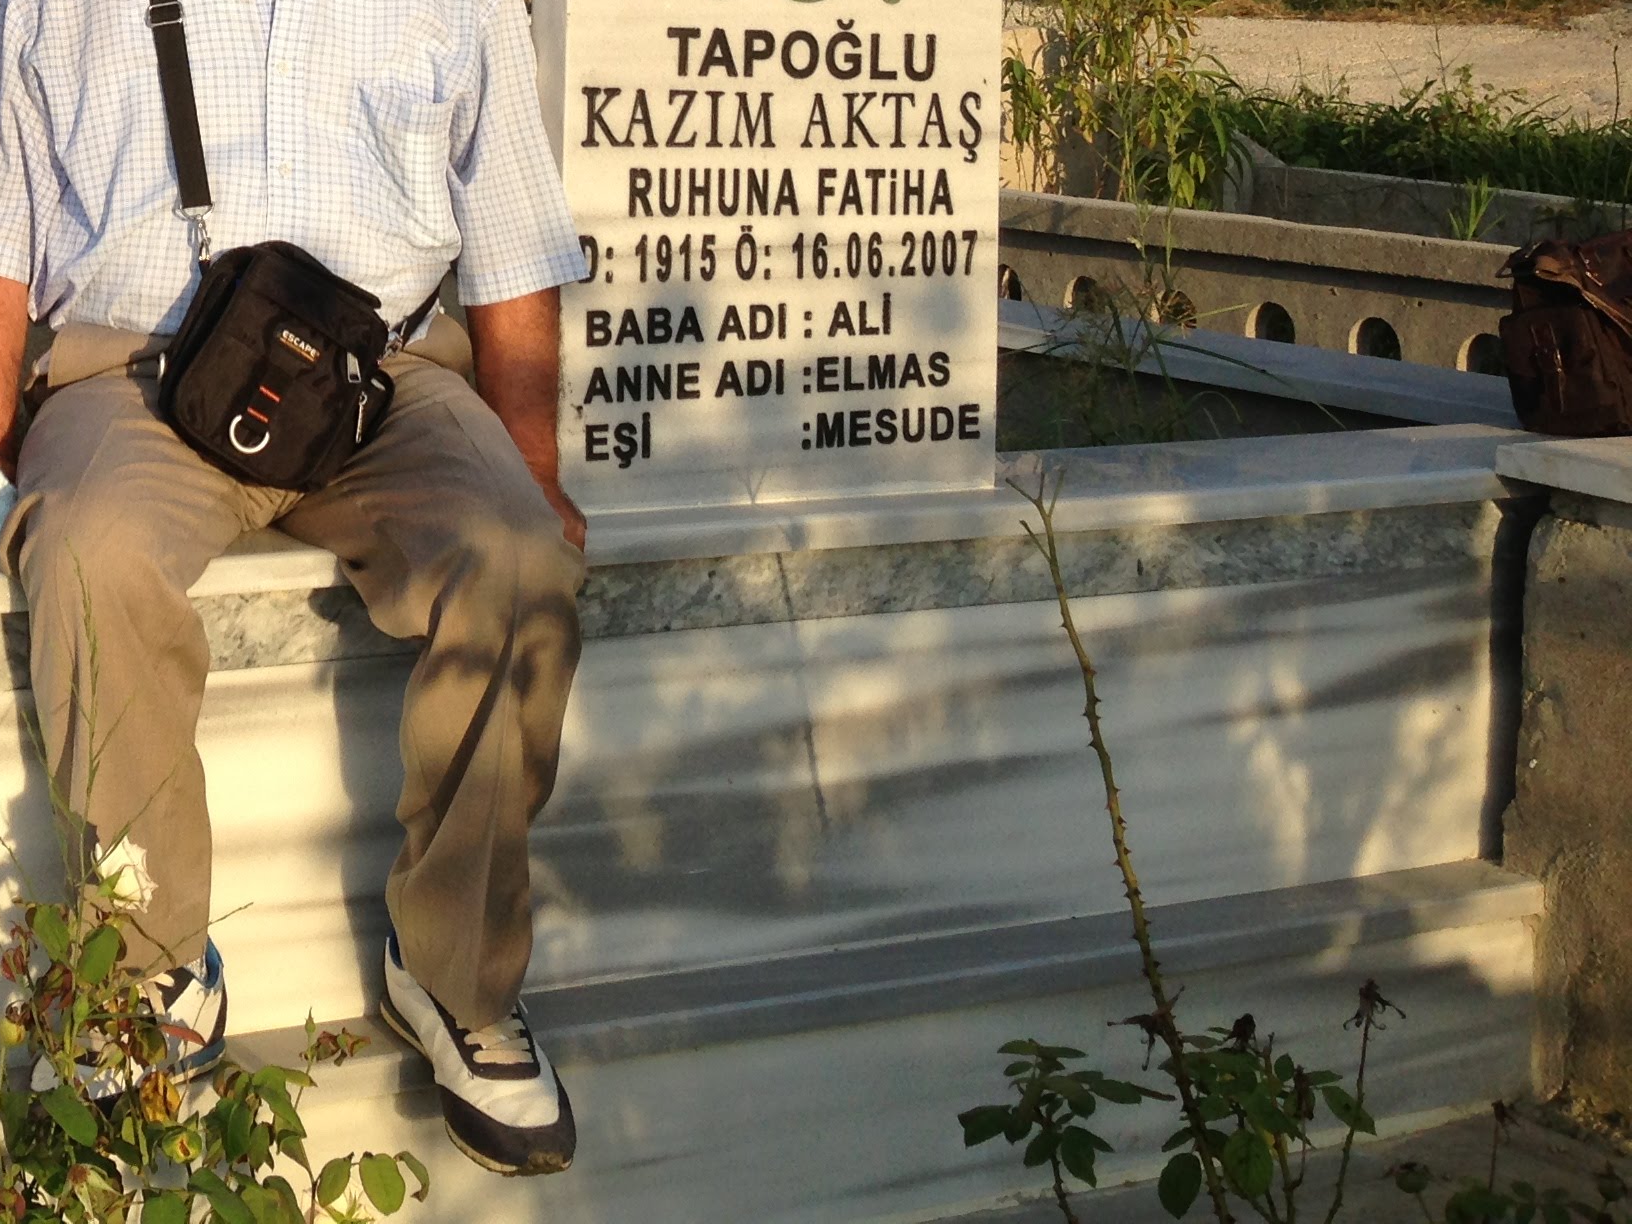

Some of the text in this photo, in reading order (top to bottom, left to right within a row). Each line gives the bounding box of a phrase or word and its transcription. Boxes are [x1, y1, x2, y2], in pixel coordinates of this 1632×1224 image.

[668, 19, 937, 81] TAPOĞLU
[581, 87, 983, 163] KAZIM AKTAŞ
[628, 168, 800, 218] RUHUNA
[634, 234, 716, 282] 1915
[735, 226, 771, 281] Ö:
[790, 230, 978, 278] 16.06.2007
[586, 306, 704, 347] BABA
[717, 303, 788, 342] ADI
[828, 293, 892, 337] ALİ
[584, 352, 950, 404] ANNE ADI :ELMAS
[585, 404, 981, 468] EŞİ :MESUDE
